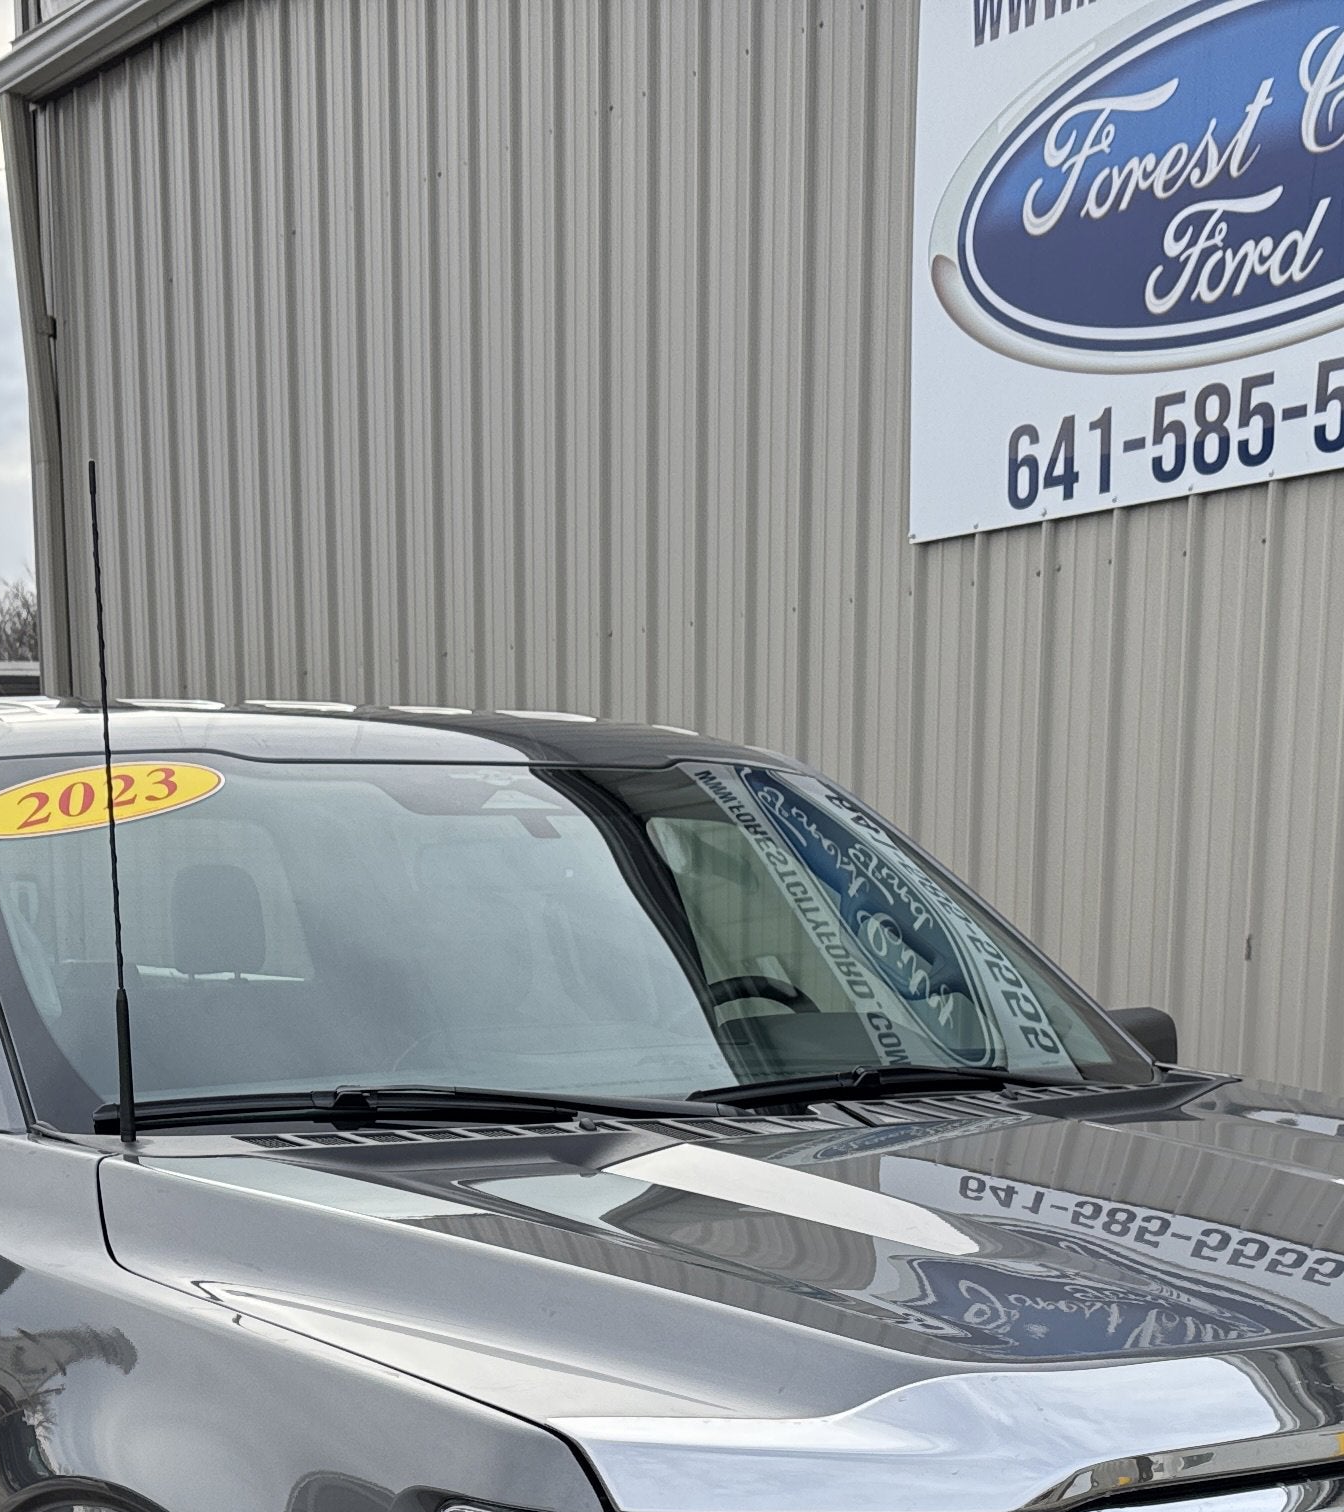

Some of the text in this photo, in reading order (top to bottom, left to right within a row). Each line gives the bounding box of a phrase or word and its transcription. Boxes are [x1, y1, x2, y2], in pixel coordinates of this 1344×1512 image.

[1022, 76, 1273, 236] Forest
[1145, 184, 1333, 315] Ford
[16, 767, 178, 831] 2023
